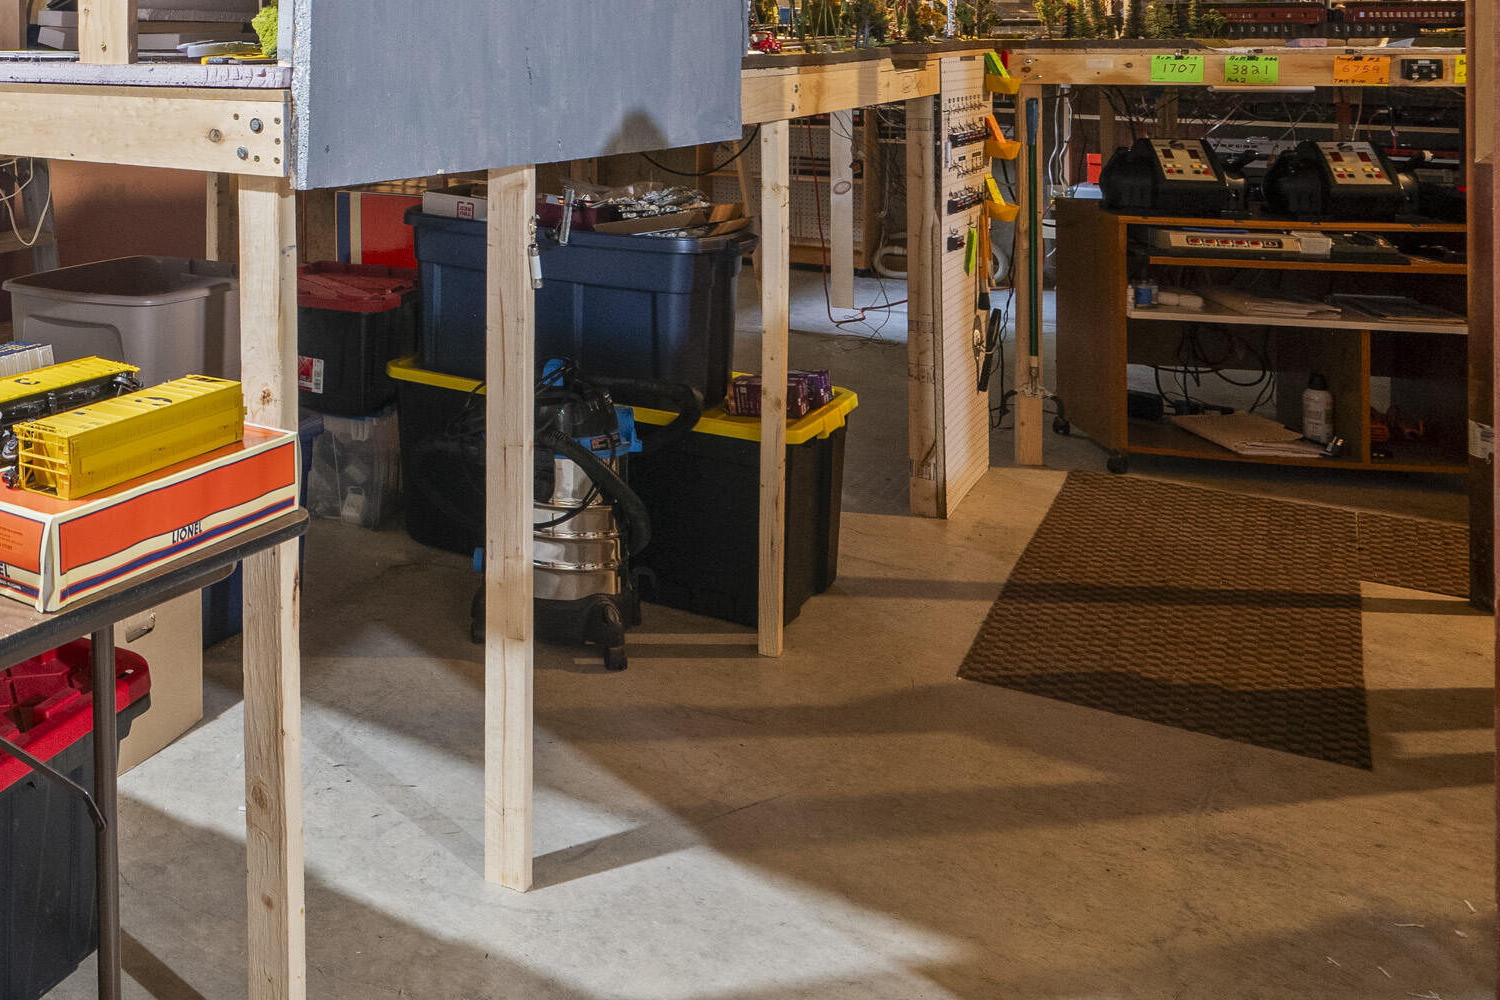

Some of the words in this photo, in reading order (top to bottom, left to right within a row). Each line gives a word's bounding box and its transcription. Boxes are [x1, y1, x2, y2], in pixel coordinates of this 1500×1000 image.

[1229, 25, 1289, 34] LIONEL
[1334, 24, 1397, 33] LIONEL
[1163, 63, 1197, 74] 1707
[1232, 64, 1269, 75] 3821
[1341, 65, 1380, 74] 6759
[171, 519, 203, 545] LIONEL
